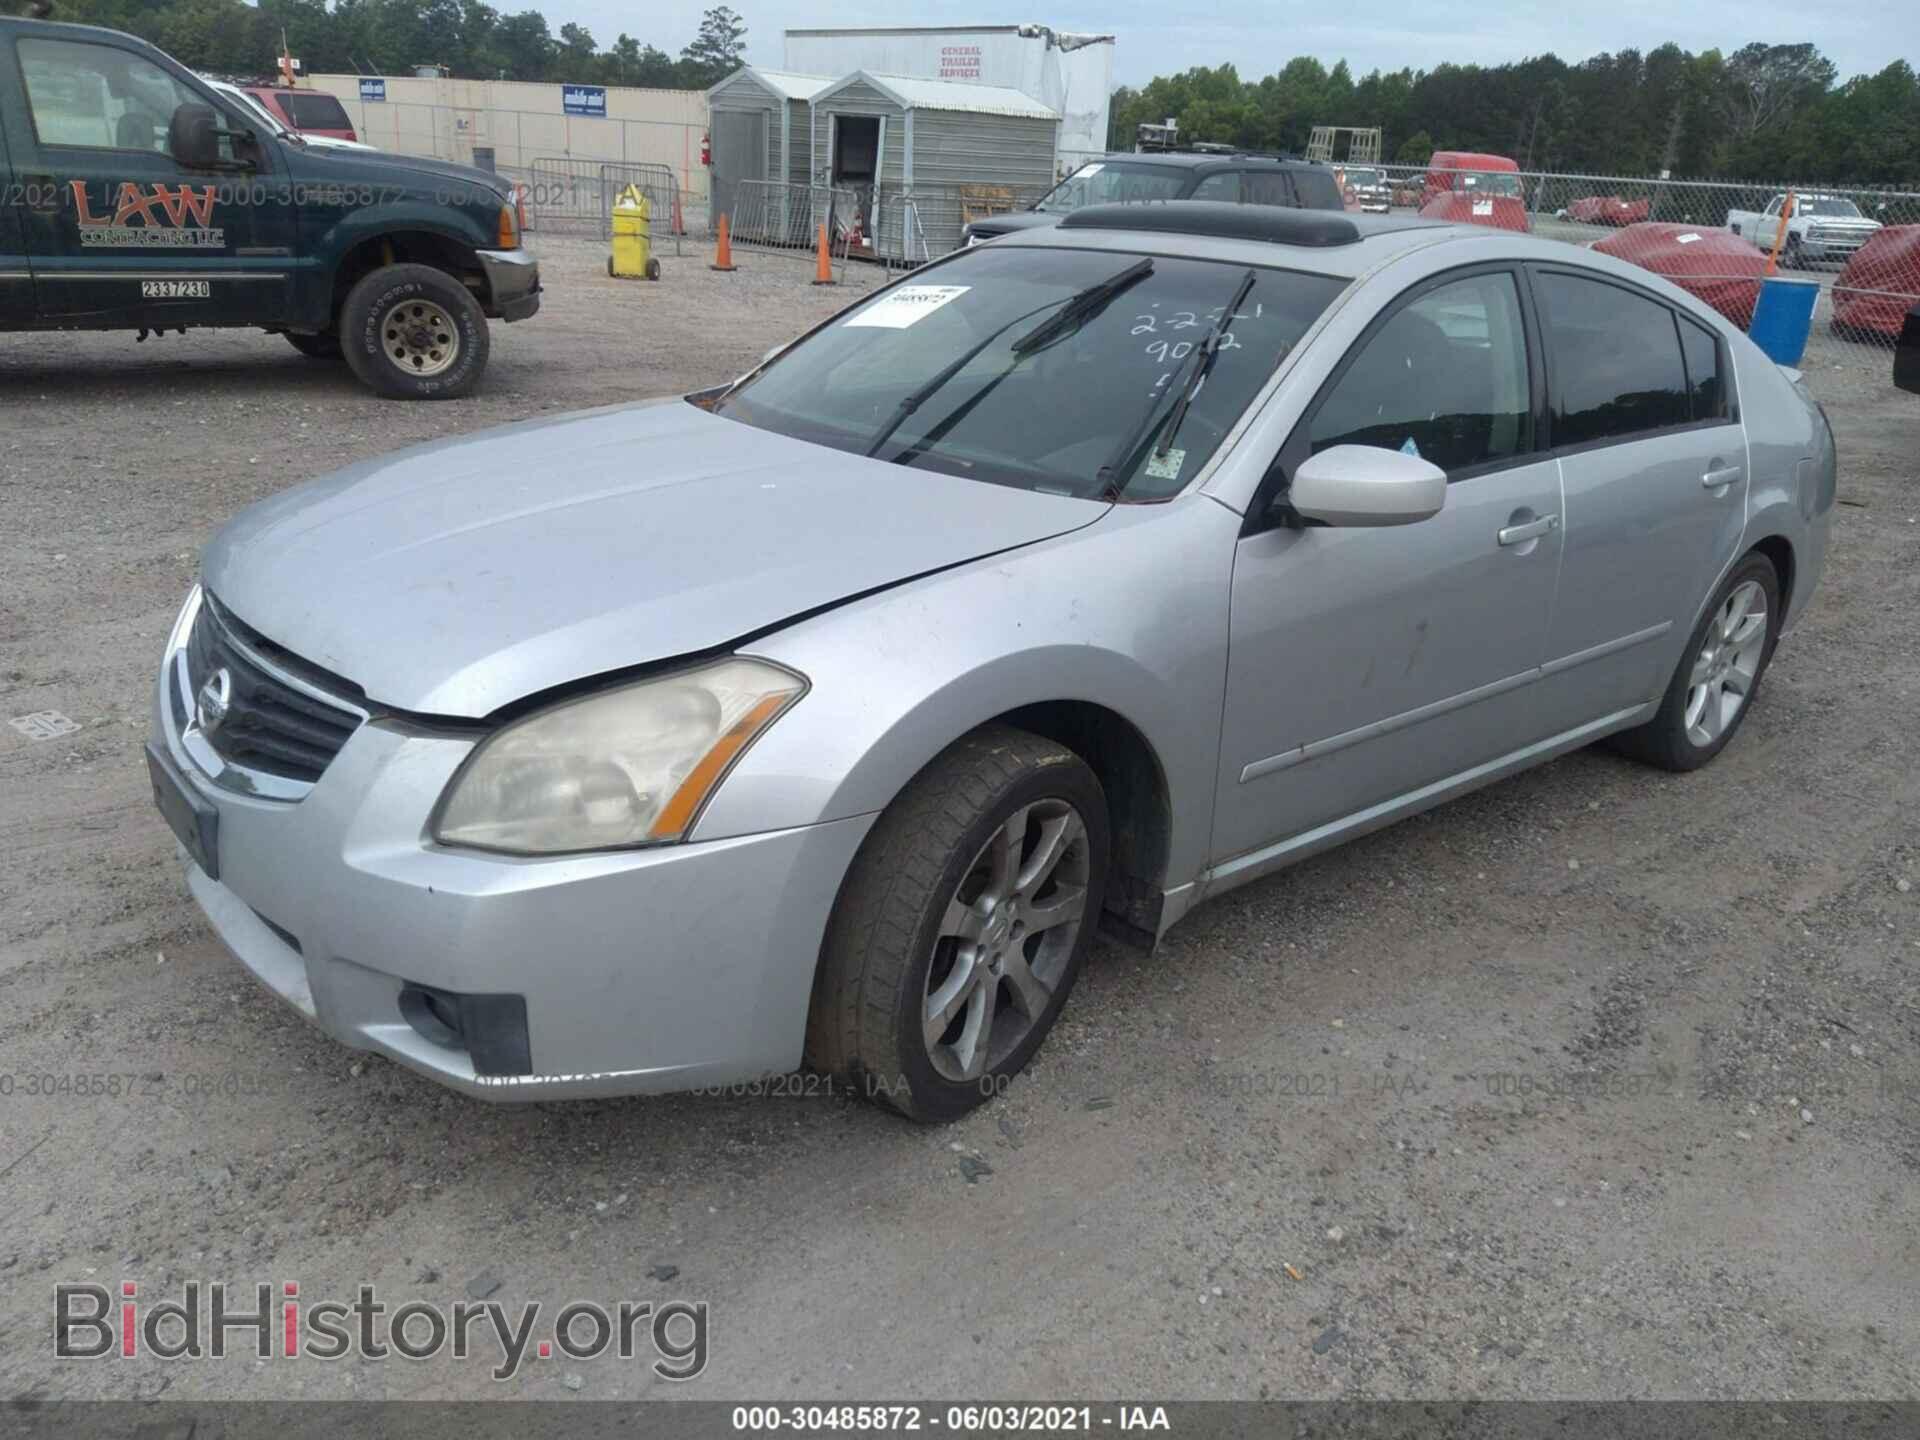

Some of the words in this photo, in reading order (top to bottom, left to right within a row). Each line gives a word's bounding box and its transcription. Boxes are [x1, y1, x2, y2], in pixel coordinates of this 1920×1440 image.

[942, 47, 982, 55] GENERAL
[942, 57, 980, 66] TRAILER
[940, 68, 980, 78] SERVICES
[69, 180, 216, 229] LAW
[80, 230, 192, 243] CONTRACTING
[143, 281, 209, 297] 2337230
[1145, 333, 1241, 362] 902
